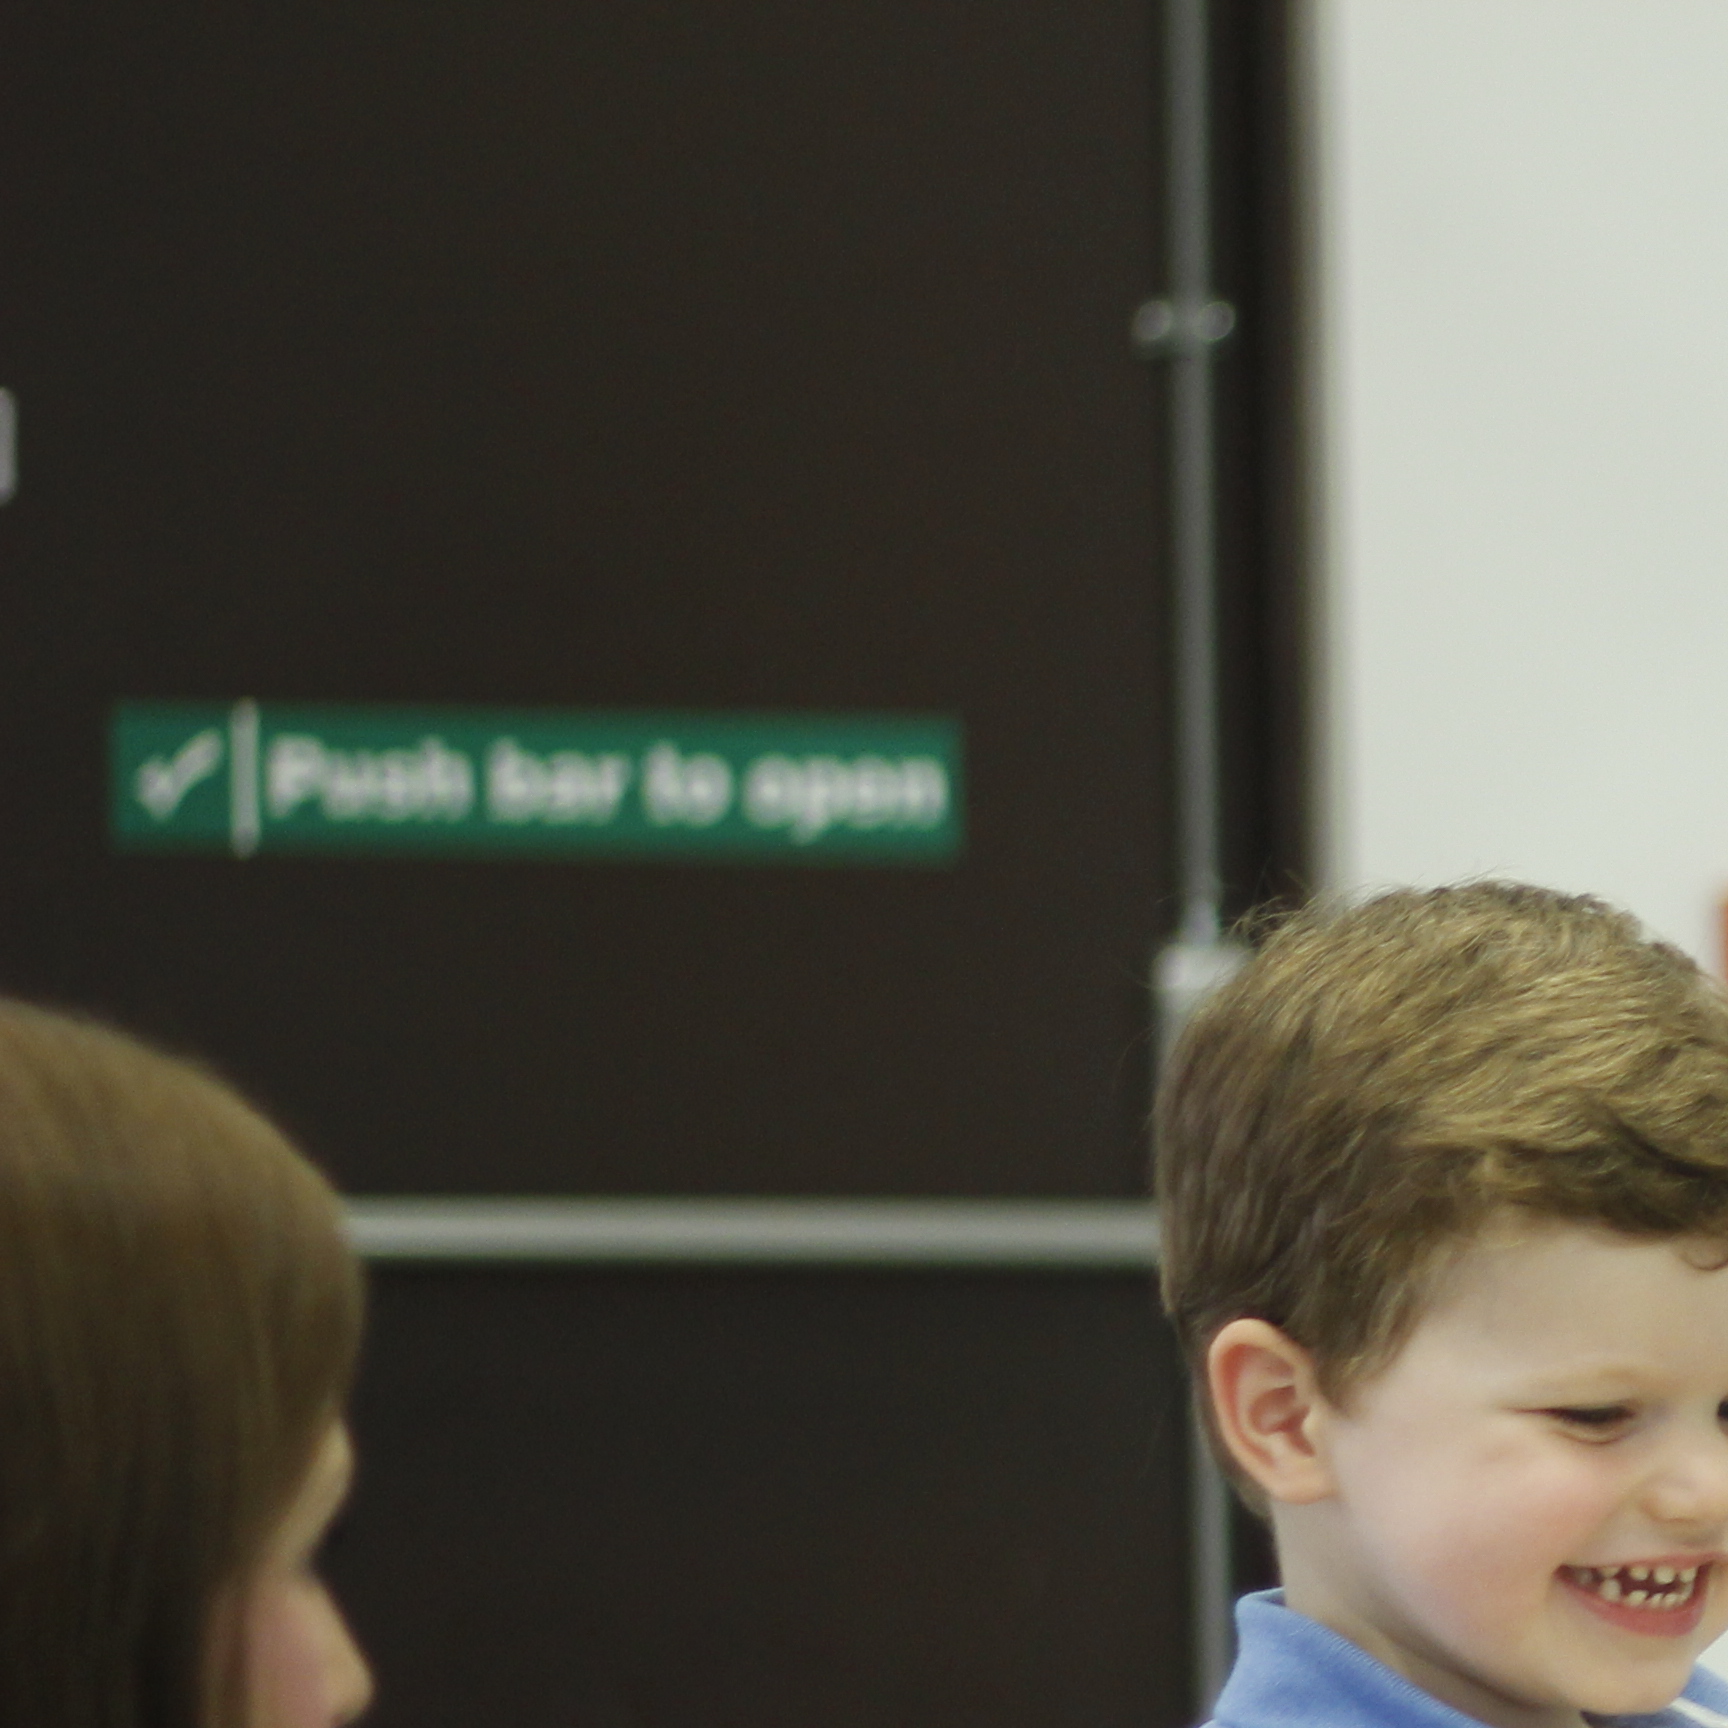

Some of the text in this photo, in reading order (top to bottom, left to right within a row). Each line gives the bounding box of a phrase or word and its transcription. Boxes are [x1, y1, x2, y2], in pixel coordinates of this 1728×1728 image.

[266, 734, 949, 846] Push bar to open
